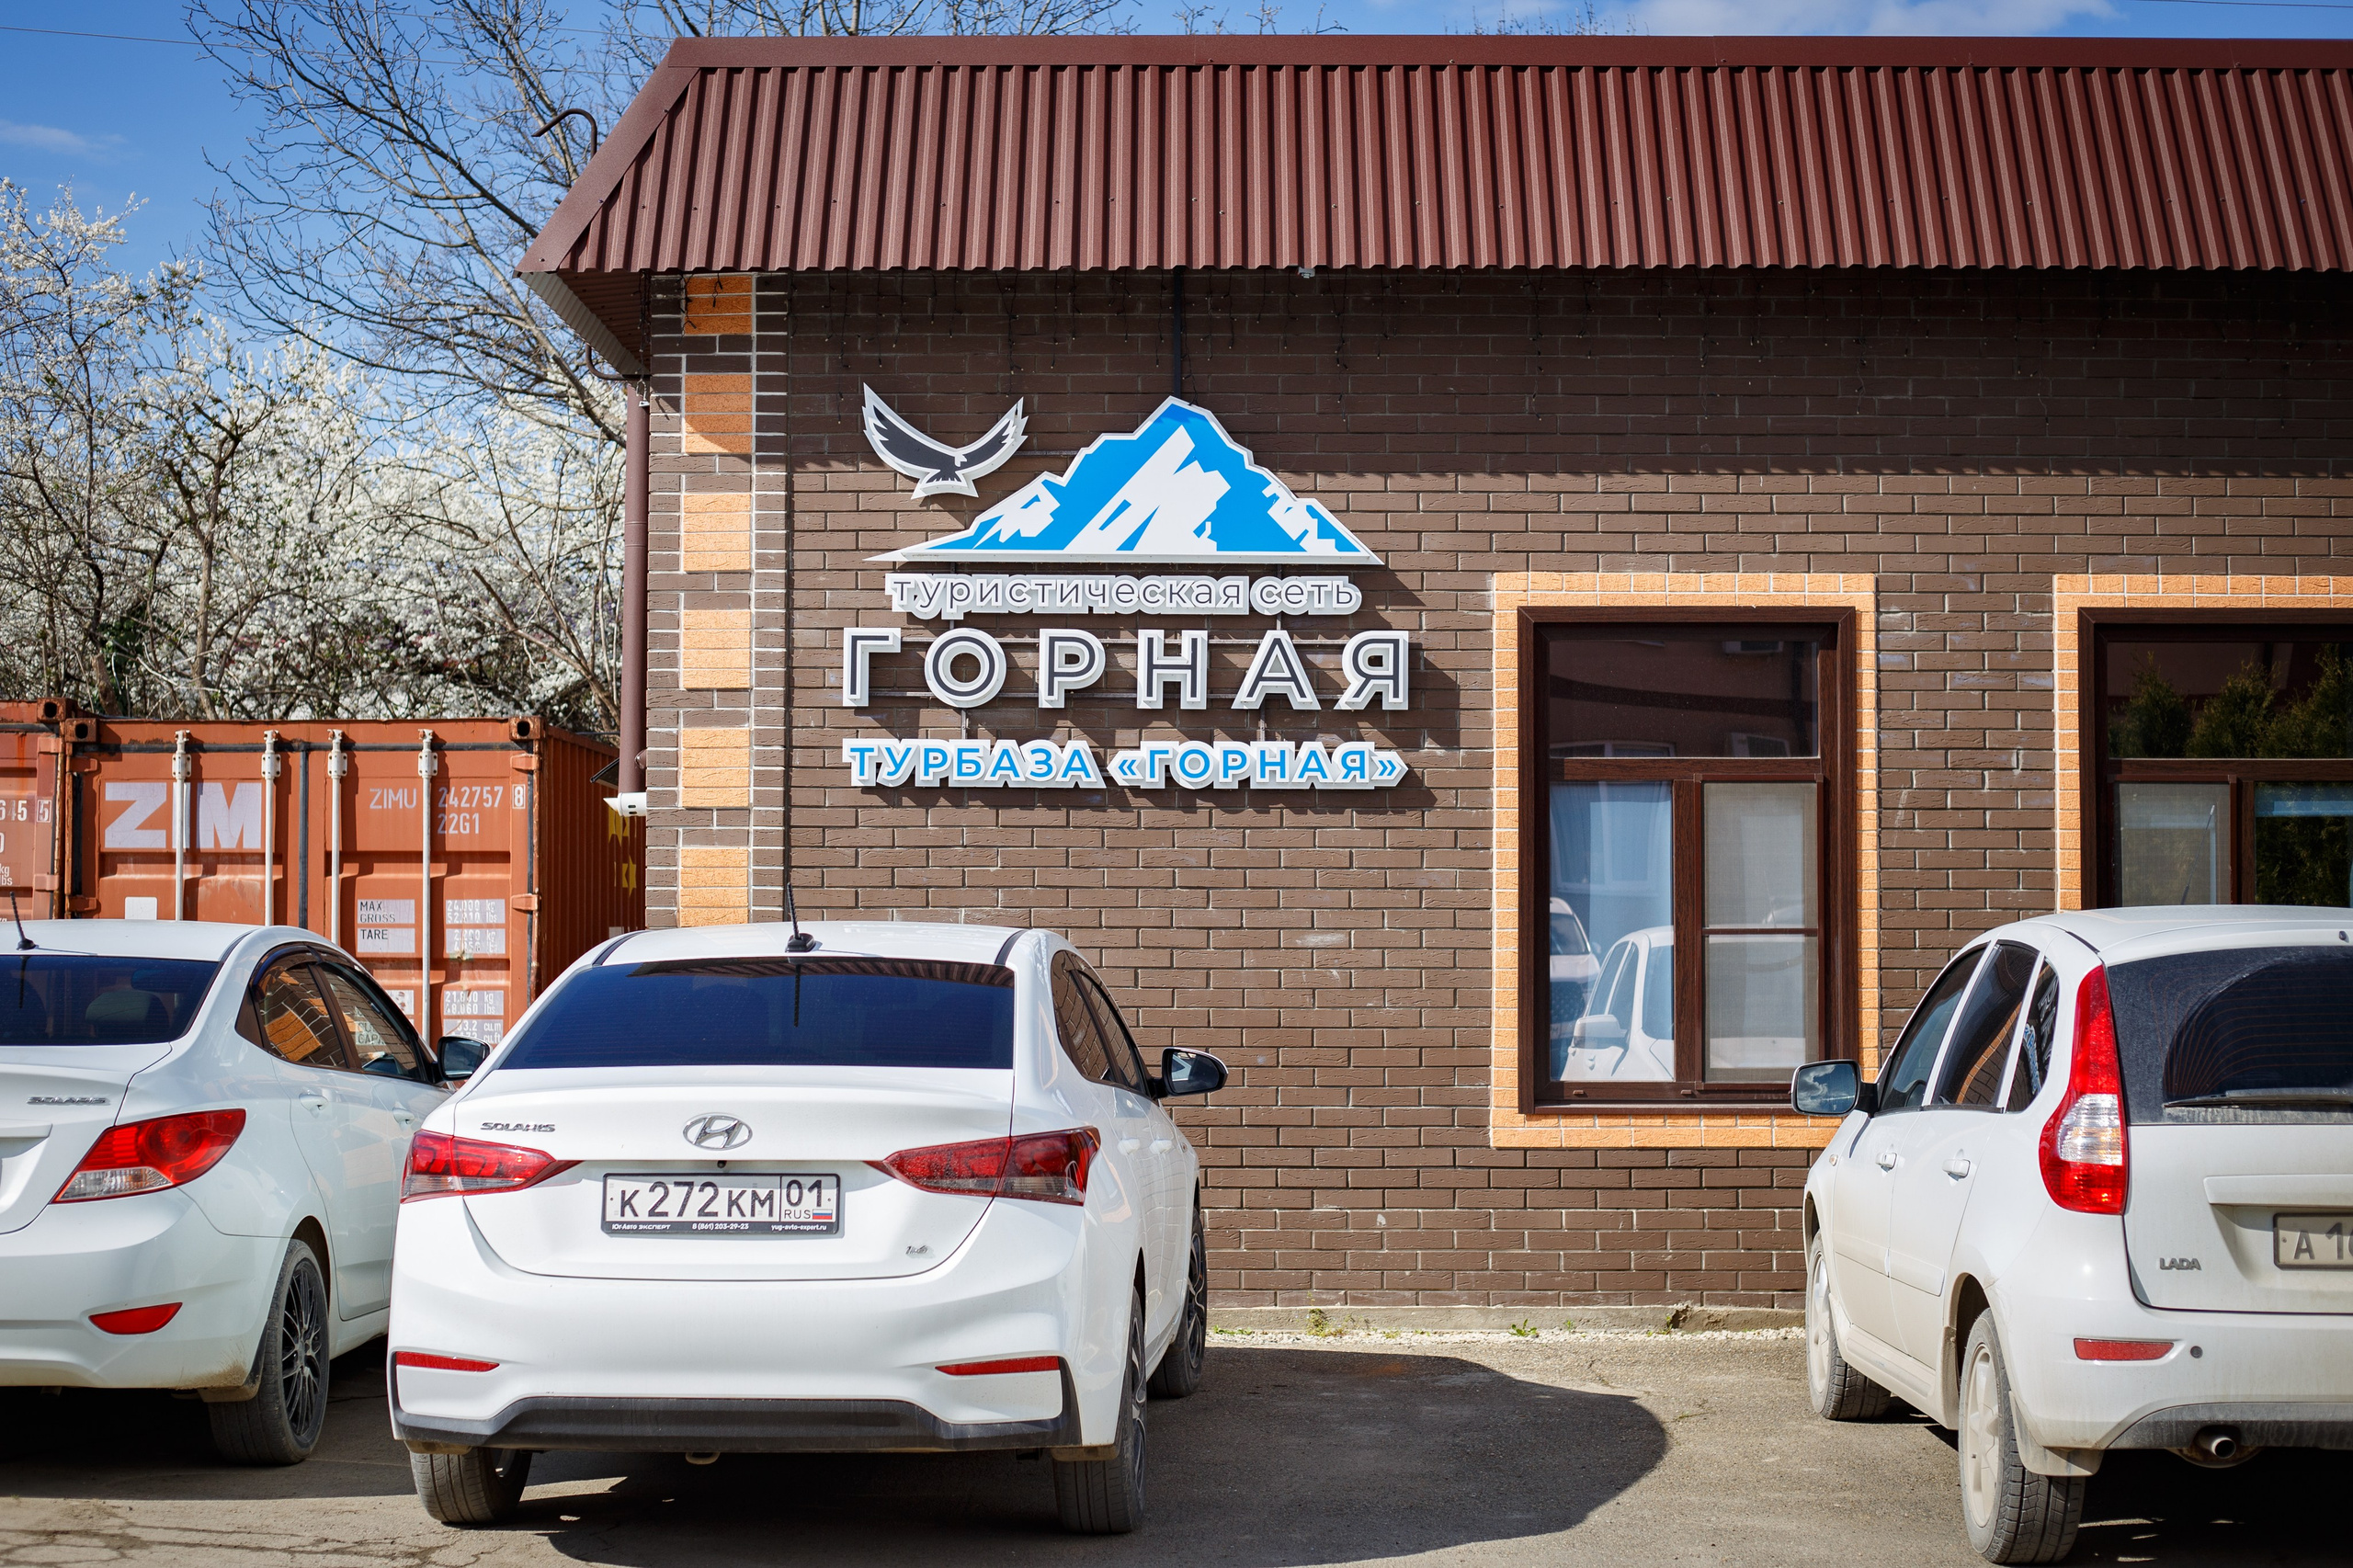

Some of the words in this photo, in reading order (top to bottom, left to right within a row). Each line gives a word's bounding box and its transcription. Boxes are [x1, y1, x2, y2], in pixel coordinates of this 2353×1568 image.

[891, 577, 1243, 614] туристическая
[1263, 578, 1358, 608] сеть
[846, 631, 1405, 706] ГОРНАЯ
[847, 744, 1097, 783] ТУРБАЗА
[1114, 744, 1402, 784] «ГОРНАЯ»
[369, 788, 417, 810] ZIMU
[438, 785, 504, 808] 242757
[513, 785, 525, 808] 8
[38, 800, 51, 822] 5
[105, 782, 262, 848] ZIM
[437, 812, 480, 835] 22G1
[359, 901, 382, 912] MAX
[359, 913, 396, 923] GROSS
[360, 929, 389, 940] TARE
[483, 991, 494, 1005] kg
[483, 1004, 495, 1015] lbs
[786, 1179, 823, 1208] 01
[784, 1209, 812, 1220] RUS
[2159, 1257, 2202, 1271] LADA
